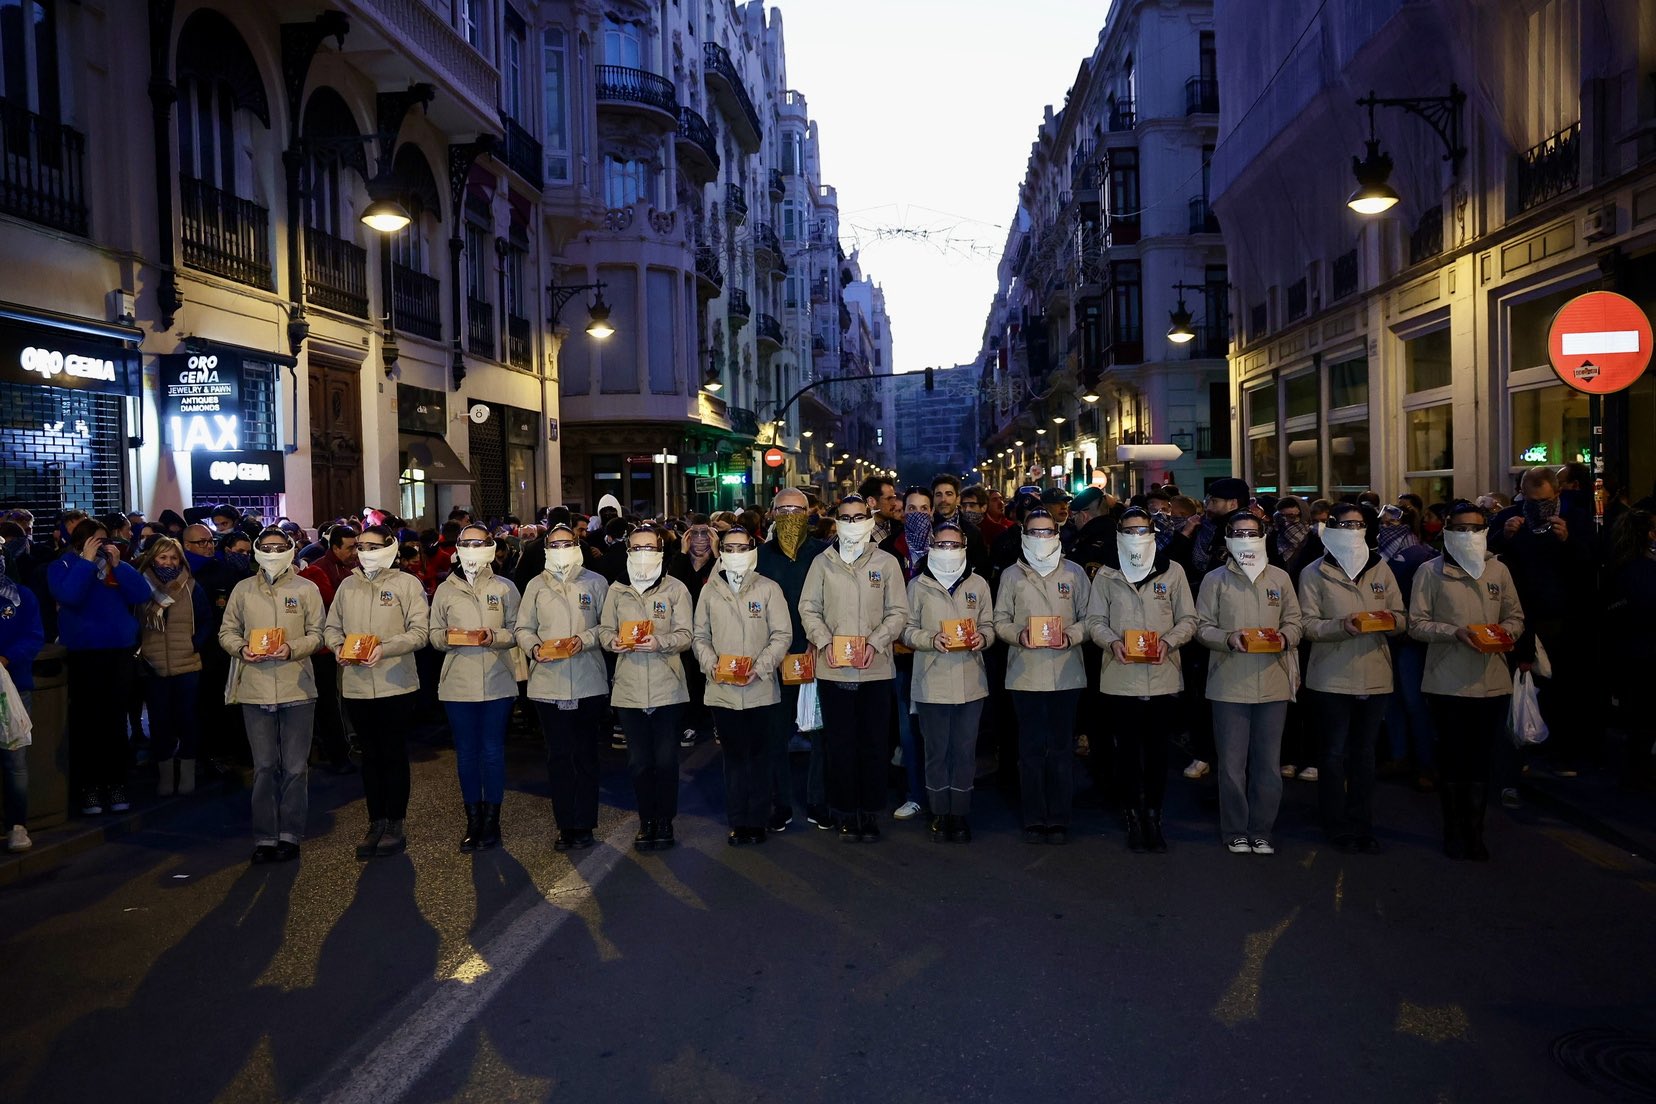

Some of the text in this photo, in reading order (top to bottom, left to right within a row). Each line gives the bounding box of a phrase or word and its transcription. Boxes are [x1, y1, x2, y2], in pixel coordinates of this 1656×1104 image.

[21, 347, 116, 381] ORO GEMA
[188, 355, 218, 370] ORO
[179, 371, 219, 384] GEMA
[168, 386, 201, 394] JEWELRY
[211, 385, 231, 393] PAWN
[181, 396, 219, 404] ANTIQUES
[181, 404, 220, 412] DIAMONDS
